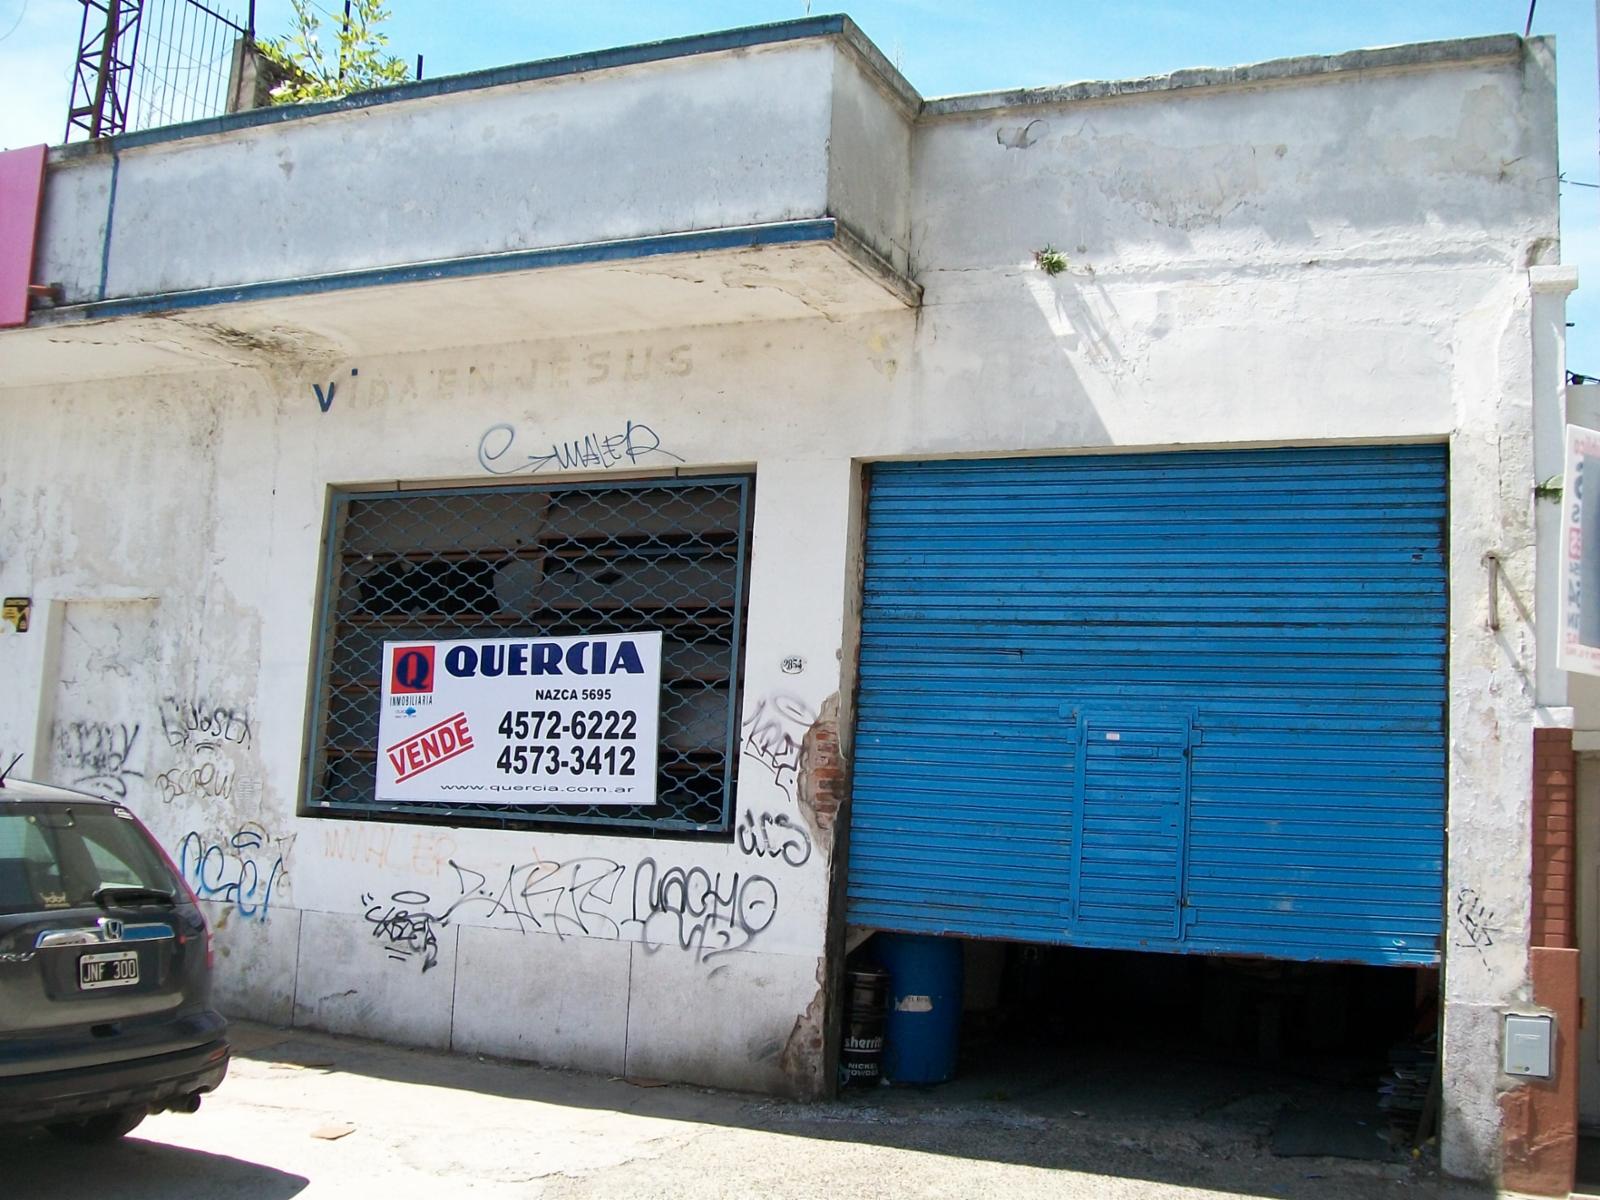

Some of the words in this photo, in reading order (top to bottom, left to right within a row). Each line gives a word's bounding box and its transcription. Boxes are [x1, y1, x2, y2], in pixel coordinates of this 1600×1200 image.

[445, 641, 645, 678] QUERCIA
[535, 689, 579, 701] NAZCA
[581, 688, 612, 701] 5695
[498, 710, 638, 741] 4572-6222
[389, 717, 474, 777] VENDE
[496, 744, 637, 776] 4573-3412
[440, 784, 635, 794] www.quercia.com.ar
[83, 962, 106, 982] JNF
[113, 959, 137, 979] 300
